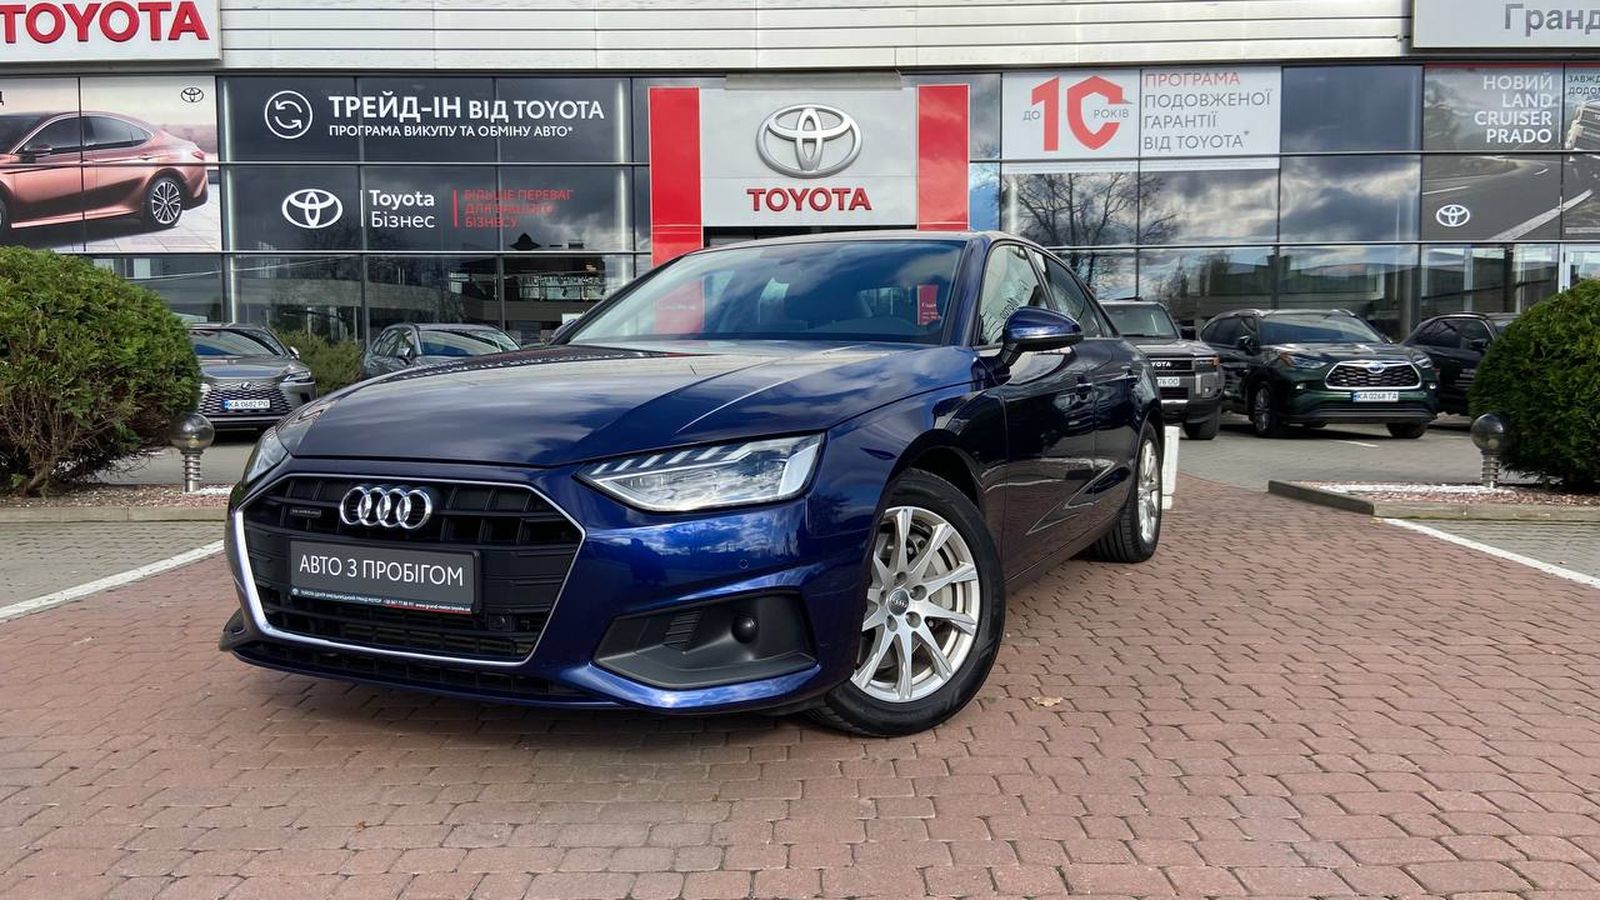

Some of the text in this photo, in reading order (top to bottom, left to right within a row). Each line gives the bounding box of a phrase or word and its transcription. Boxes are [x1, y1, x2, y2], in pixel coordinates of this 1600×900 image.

[0, 1, 210, 44] TOYOTA
[1504, 3, 1600, 37] Гранд
[1145, 71, 1240, 88] ПРОГРАМА
[1483, 72, 1552, 90] НОВИЙ
[1569, 86, 1600, 95] ДОДО
[329, 91, 605, 122] ТРЕЙД-ІН ВІД TOYOTA
[1144, 89, 1273, 110] ПОДОВЖЕНОЇ
[1502, 93, 1552, 108] LAND
[1023, 110, 1041, 121] ДО
[1093, 108, 1129, 119] РОКІВ
[1144, 111, 1218, 129] ГАРАНТІЇ
[1474, 111, 1552, 126] CRUISER
[329, 125, 401, 137] ПРОГРАМА
[404, 125, 457, 137] ВИКУПУ
[459, 125, 475, 137] ТА
[478, 125, 530, 137] ОБМІНУ
[1486, 128, 1552, 143] PRADO
[1144, 136, 1171, 152] ВІД
[369, 189, 435, 210] Toyota
[518, 188, 574, 201] ПЕРЕВАГ
[747, 187, 872, 212] TOYOTA
[371, 211, 435, 228] Бізнес
[299, 554, 342, 576] АВТО
[363, 560, 464, 587] ПРОБІГОМ
